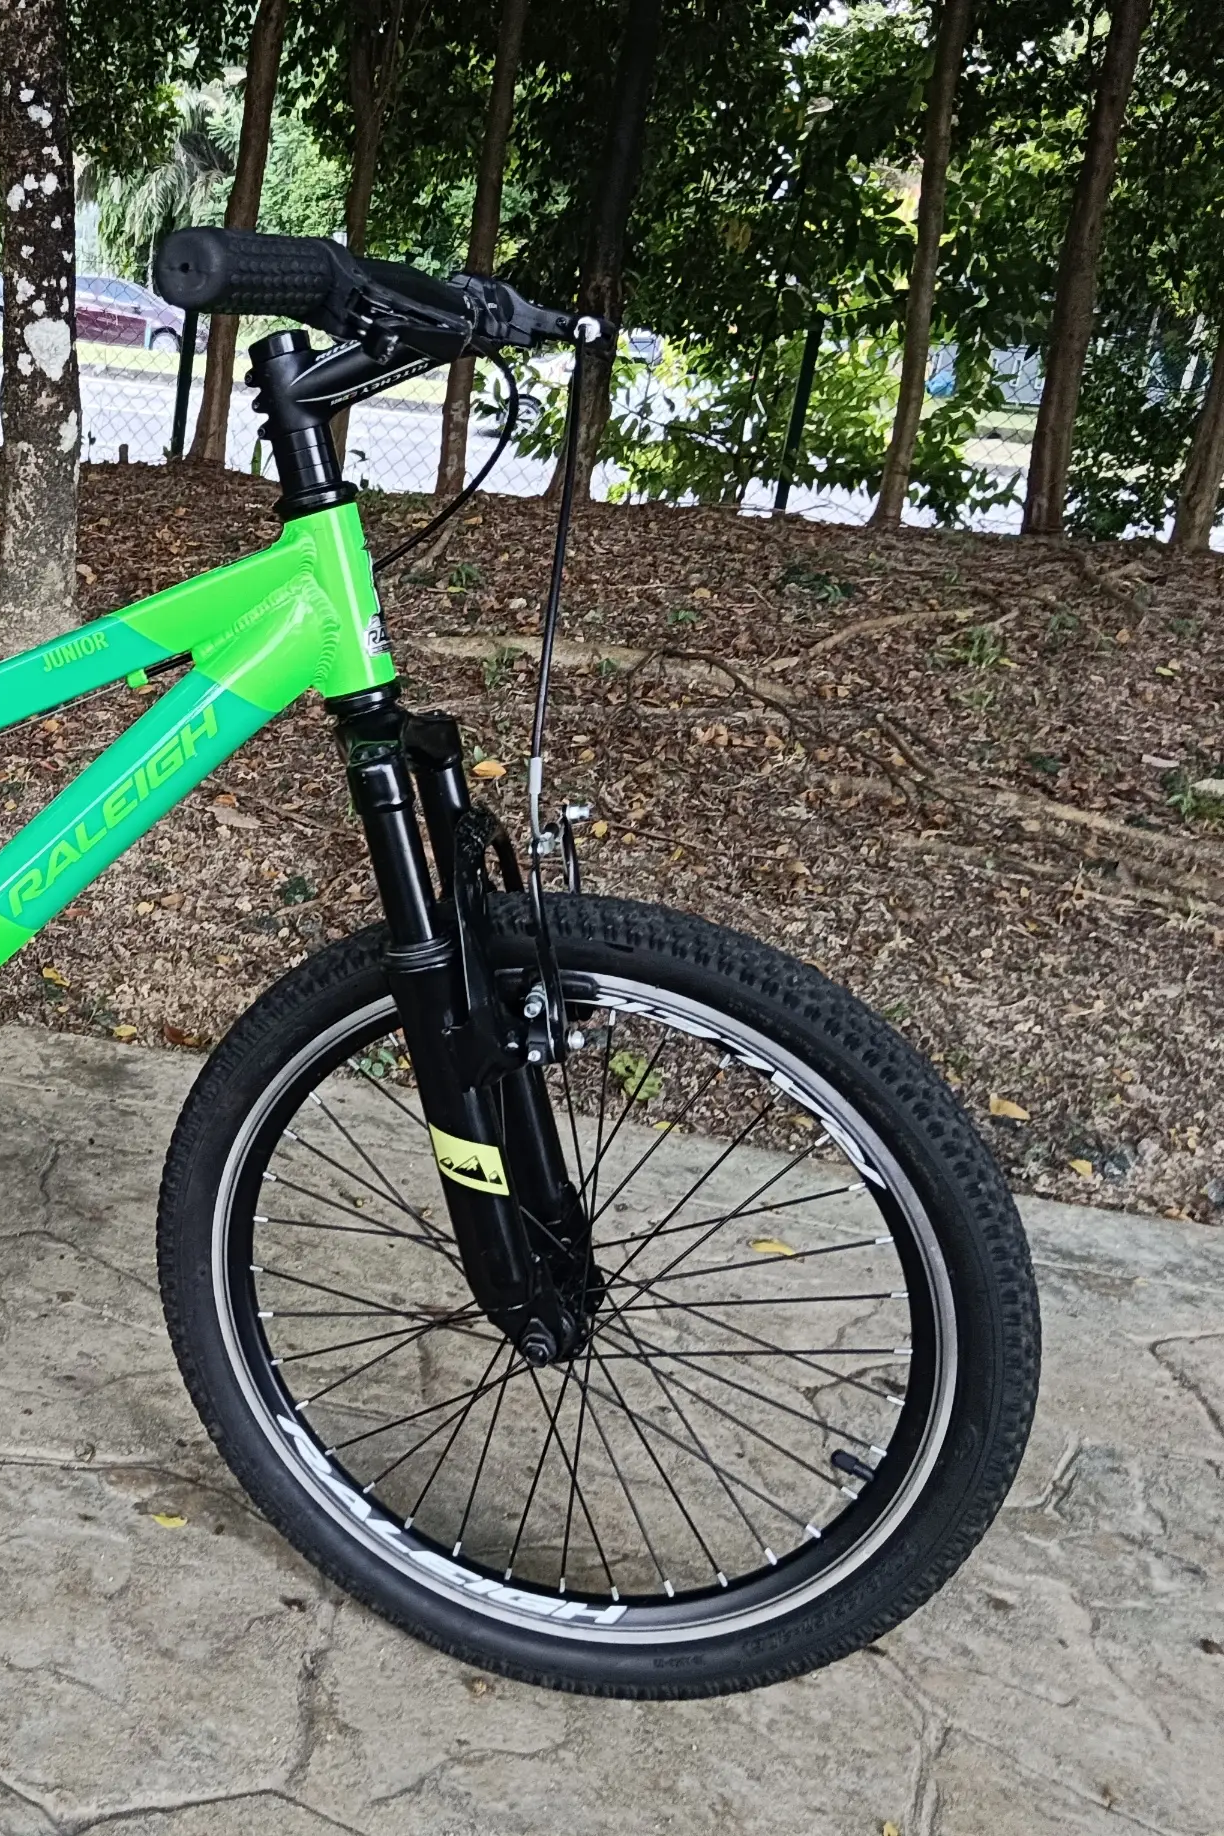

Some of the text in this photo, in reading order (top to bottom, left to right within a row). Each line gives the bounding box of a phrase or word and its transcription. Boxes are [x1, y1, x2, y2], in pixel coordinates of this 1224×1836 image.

[42, 630, 109, 672] JUNIOR
[8, 703, 218, 917] RALEIGH
[276, 1413, 628, 1625] RALEIGH
